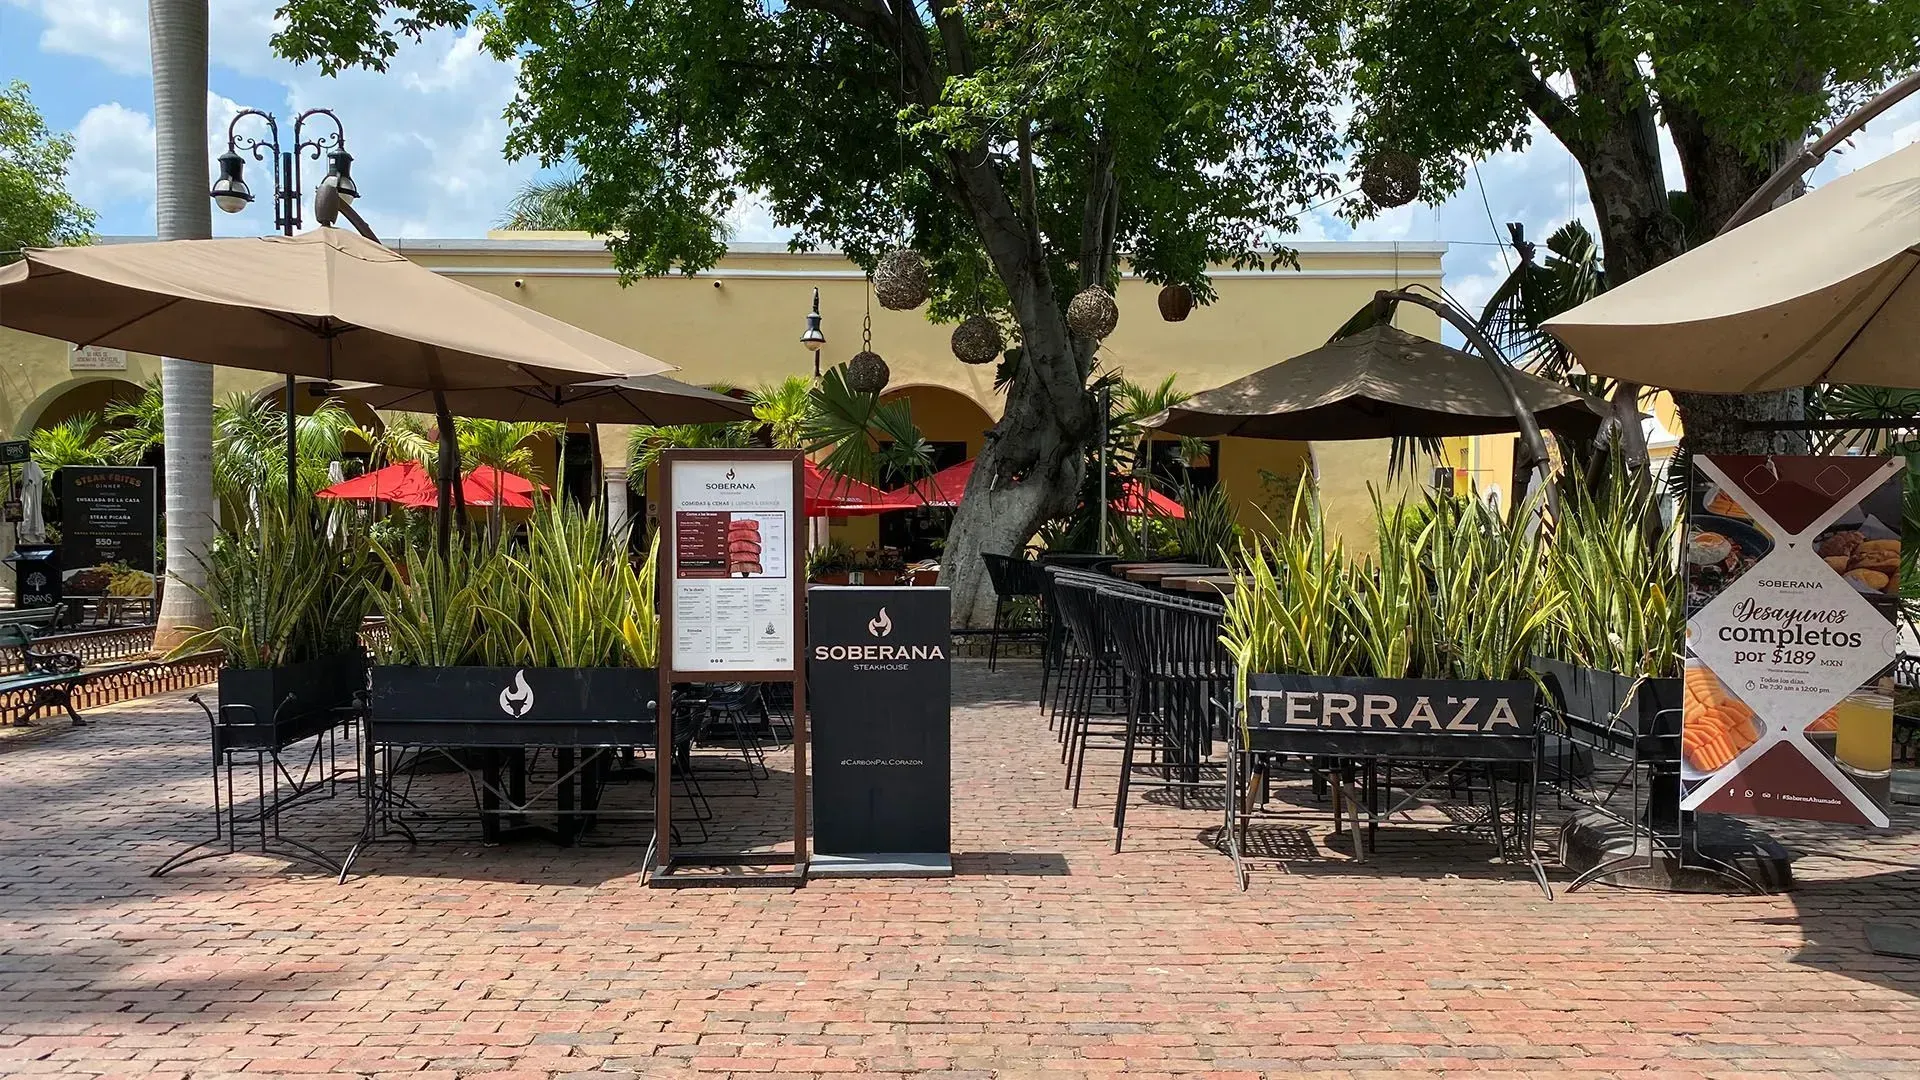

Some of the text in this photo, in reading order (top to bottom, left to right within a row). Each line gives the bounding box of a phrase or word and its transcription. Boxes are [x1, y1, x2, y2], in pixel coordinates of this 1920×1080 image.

[95, 538, 112, 546] 550
[1758, 579, 1823, 589] SOBERANA
[1732, 597, 1849, 629] Desayunos
[1718, 623, 1862, 649] completos
[815, 645, 945, 661] SOBERANA
[1733, 648, 1844, 668] por $189 MXN
[853, 663, 910, 671] STEAKHOUSE
[1760, 676, 1779, 684] Todos
[1249, 688, 1520, 732] TERRAZA
